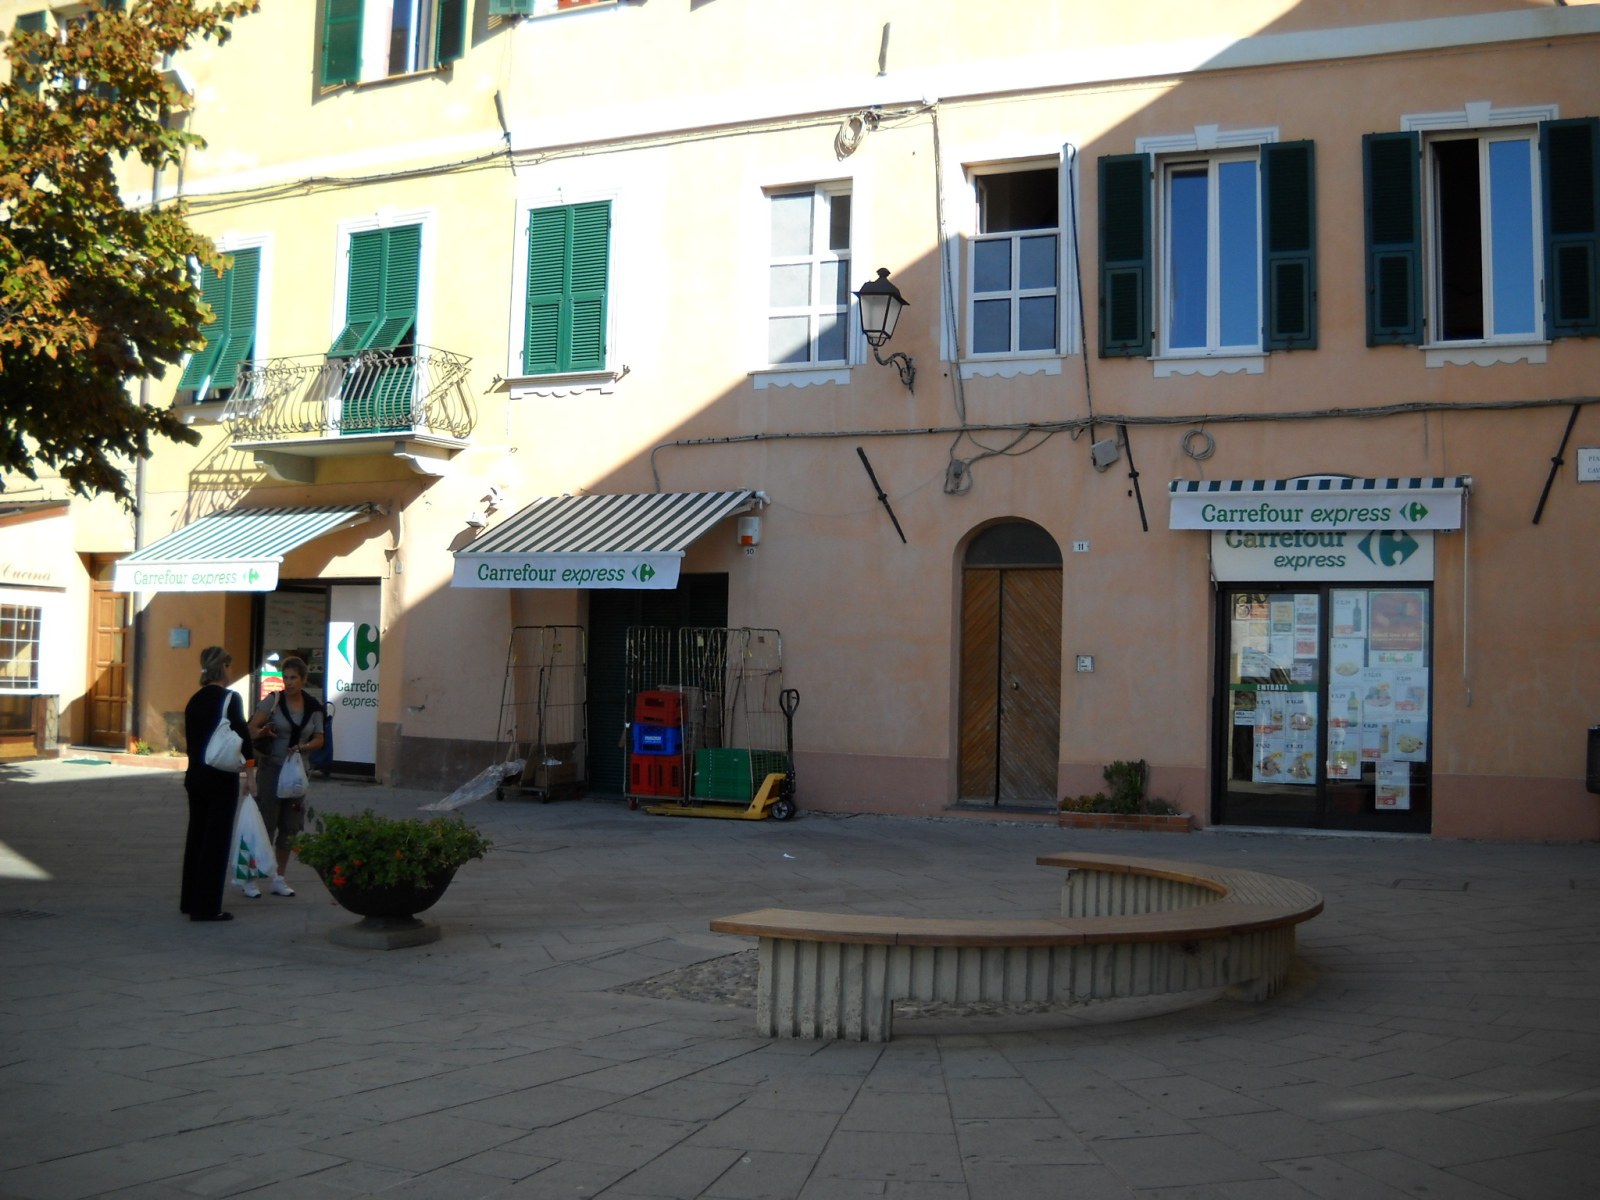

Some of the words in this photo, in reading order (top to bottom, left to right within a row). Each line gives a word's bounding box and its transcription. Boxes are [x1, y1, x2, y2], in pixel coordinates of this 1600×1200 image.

[1201, 503, 1304, 523] Carrefour
[1310, 506, 1391, 526] express
[1225, 529, 1347, 548] Carrefour
[1273, 553, 1346, 571] express
[134, 569, 188, 585] Carrefour
[191, 571, 237, 587] express
[477, 563, 557, 582] Carrefour
[561, 567, 625, 585] express
